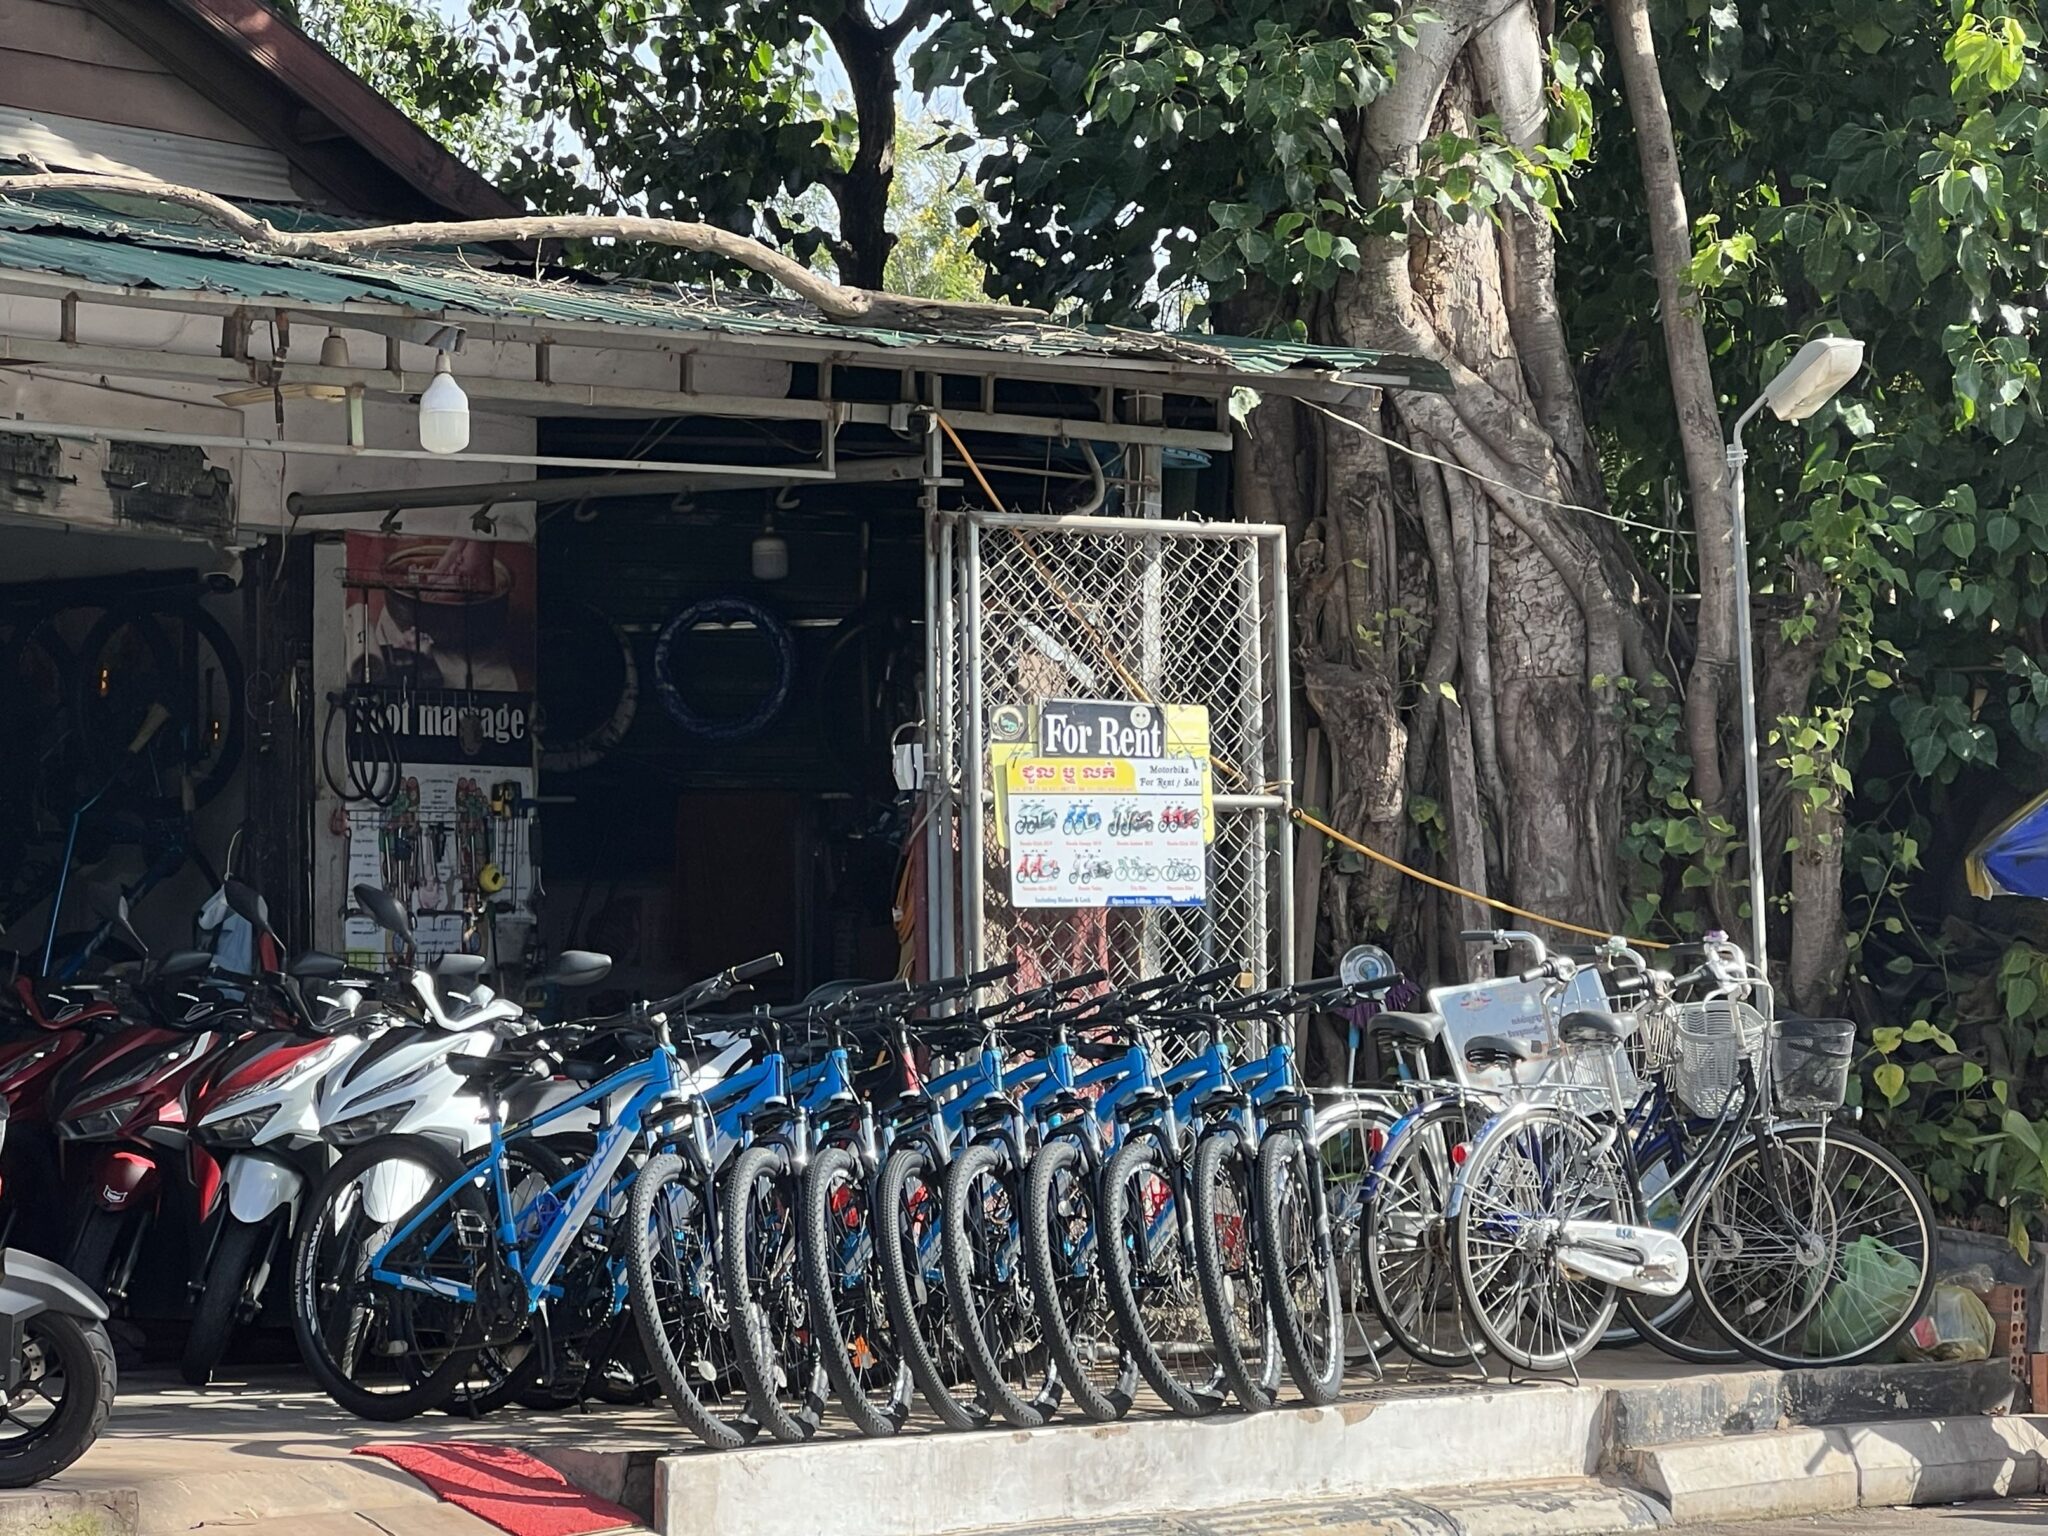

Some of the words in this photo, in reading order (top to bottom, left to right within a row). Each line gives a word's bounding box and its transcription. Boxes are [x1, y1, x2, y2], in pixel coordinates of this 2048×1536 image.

[418, 702, 524, 744] maage
[1045, 713, 1093, 754] For
[1098, 716, 1162, 758] Rent
[1139, 777, 1154, 787] For
[1157, 777, 1175, 789] Rent
[1184, 777, 1200, 787] Sale
[1150, 765, 1190, 774] Motorbike
[562, 1120, 624, 1216] TRINX
